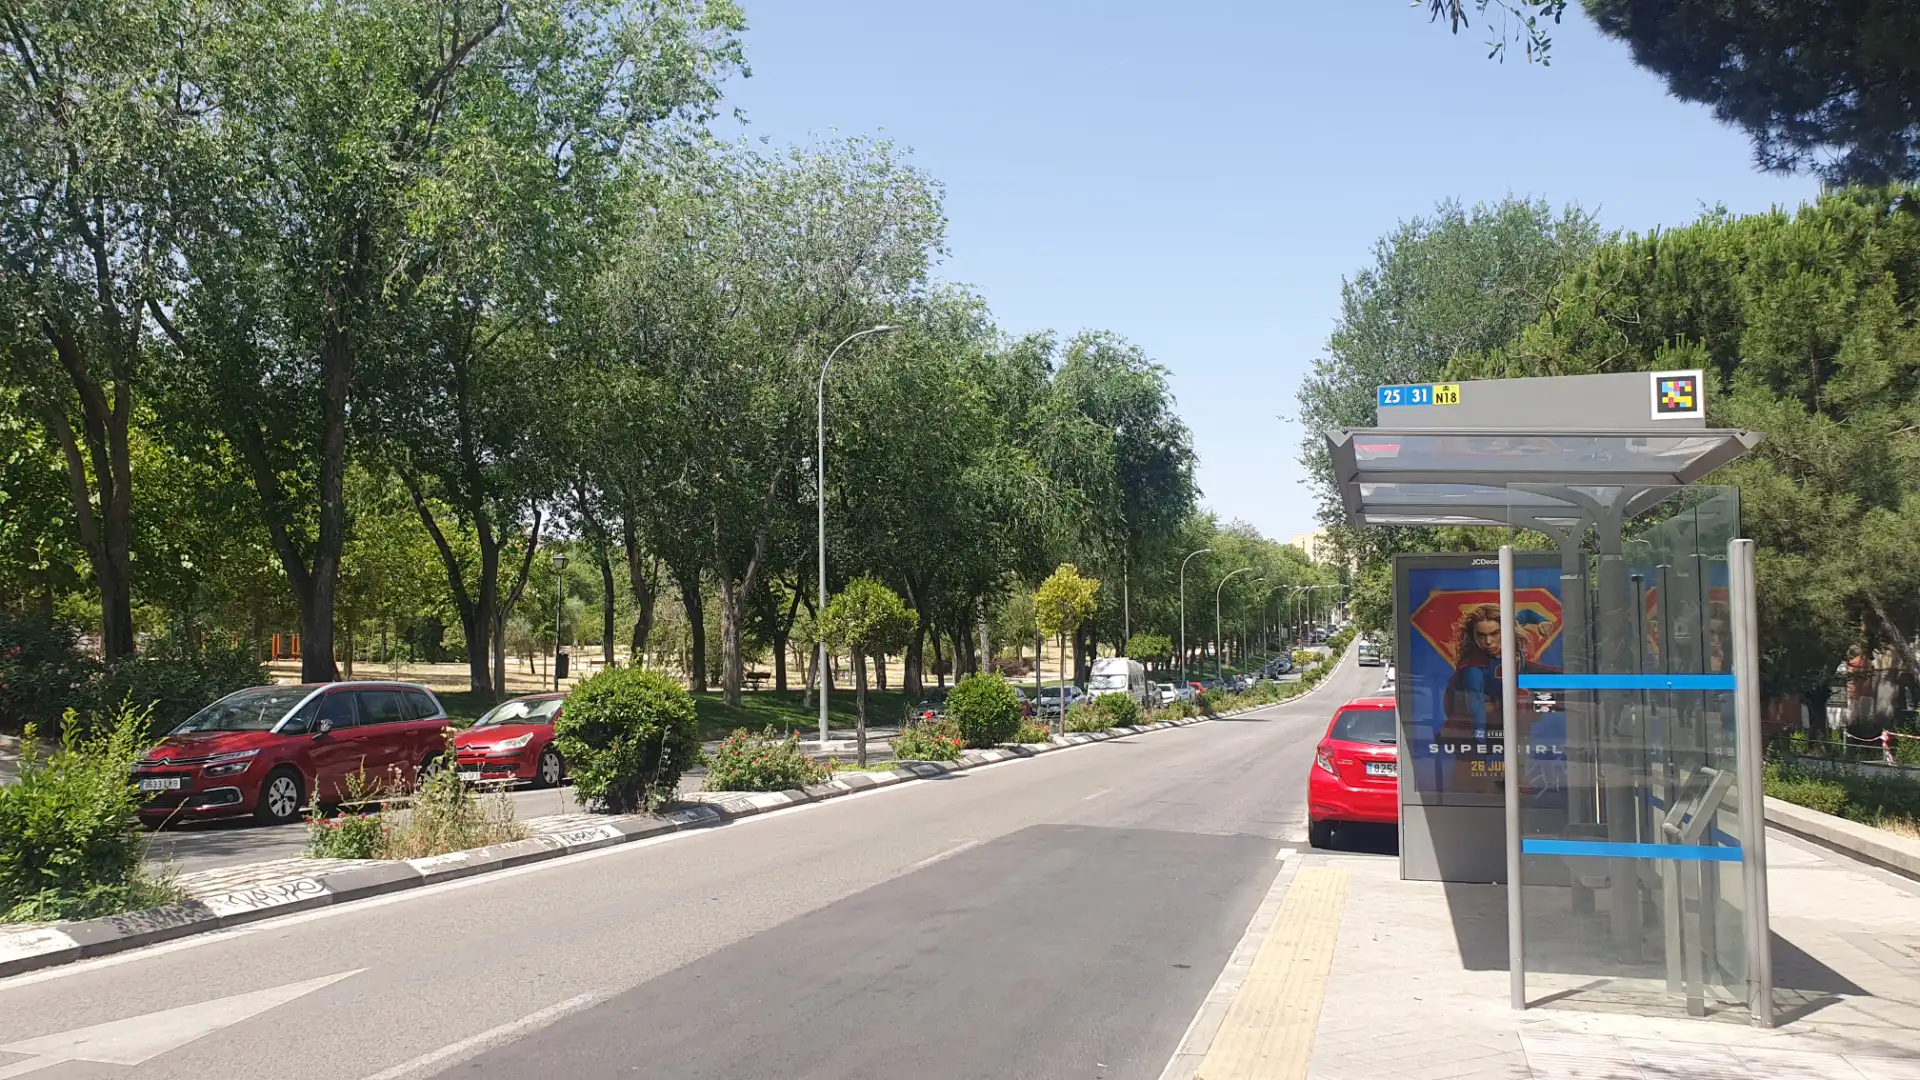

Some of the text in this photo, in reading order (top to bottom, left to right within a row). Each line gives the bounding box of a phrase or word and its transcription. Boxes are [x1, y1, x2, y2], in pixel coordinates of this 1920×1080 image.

[1384, 388, 1457, 404] 25 31 N18
[1471, 558, 1499, 566] JCDeca
[1428, 743, 1563, 755] SUPERIRL
[1471, 761, 1485, 772] 26
